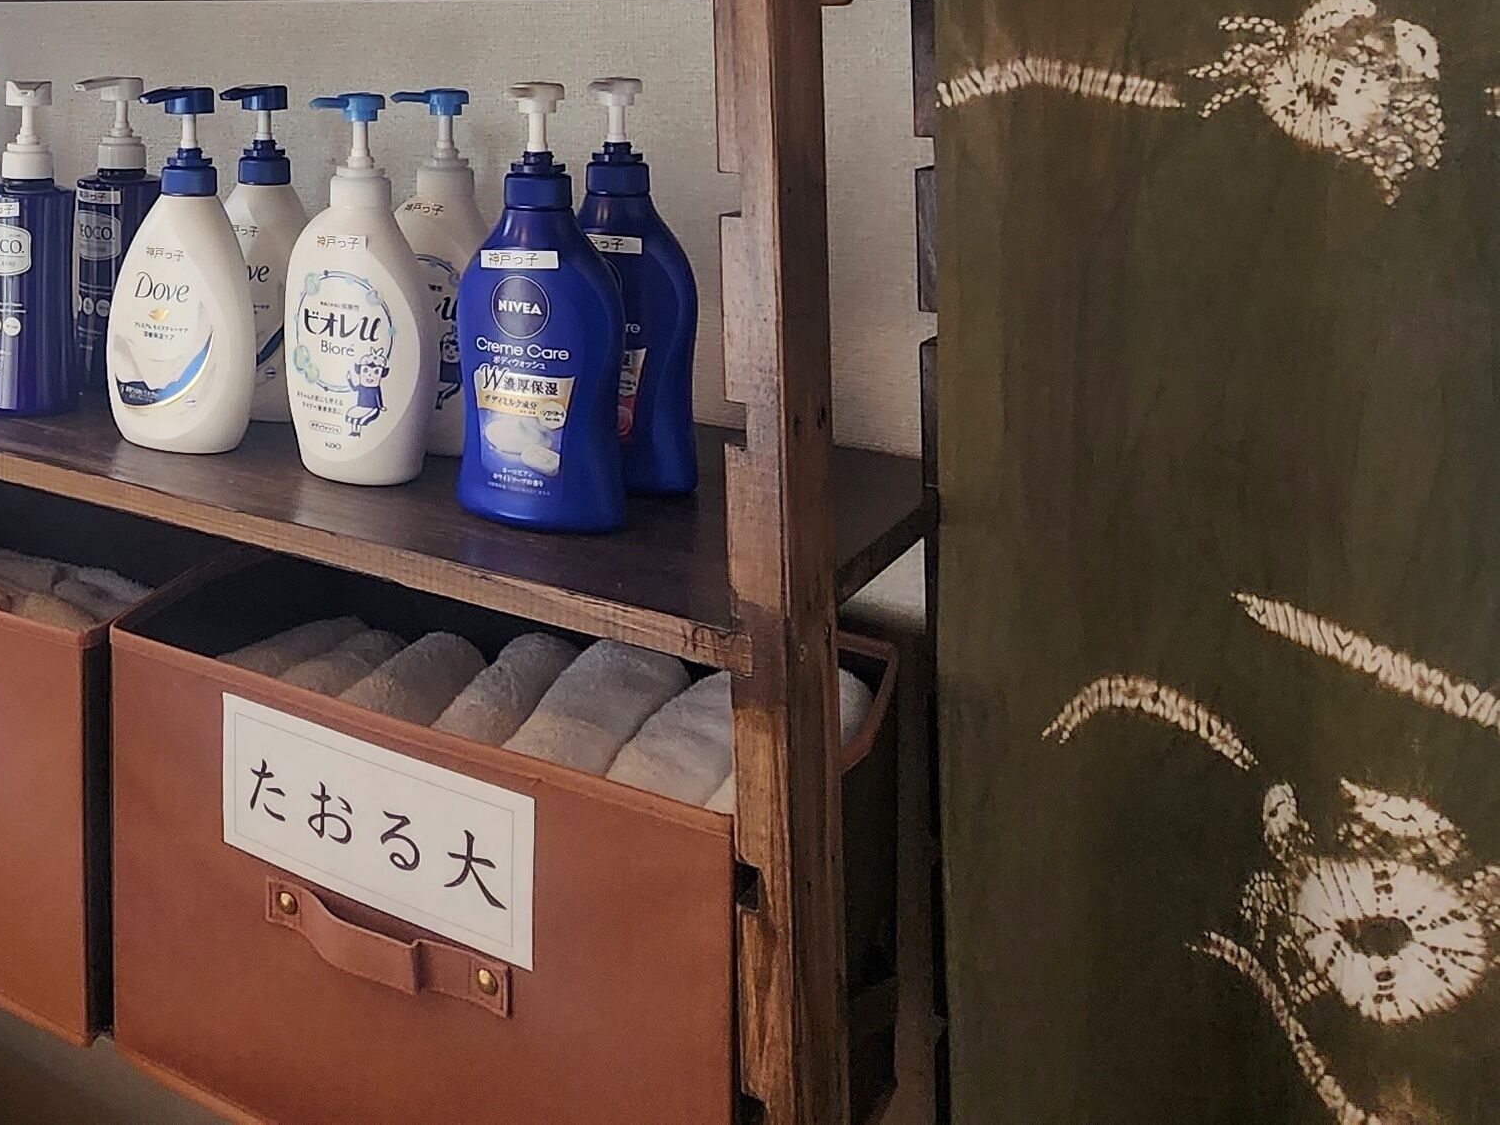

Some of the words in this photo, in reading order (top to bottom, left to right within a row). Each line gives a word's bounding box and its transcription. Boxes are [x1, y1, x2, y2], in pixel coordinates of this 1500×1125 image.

[316, 235, 360, 250] 神戸っ子
[488, 252, 539, 267] 神戸っ子
[247, 265, 270, 283] ve
[134, 270, 190, 303] Dove
[497, 298, 543, 316] NIVEA
[625, 322, 641, 334] re
[476, 336, 524, 357] Creme
[526, 343, 570, 362] Care
[249, 757, 508, 911] たおる大
